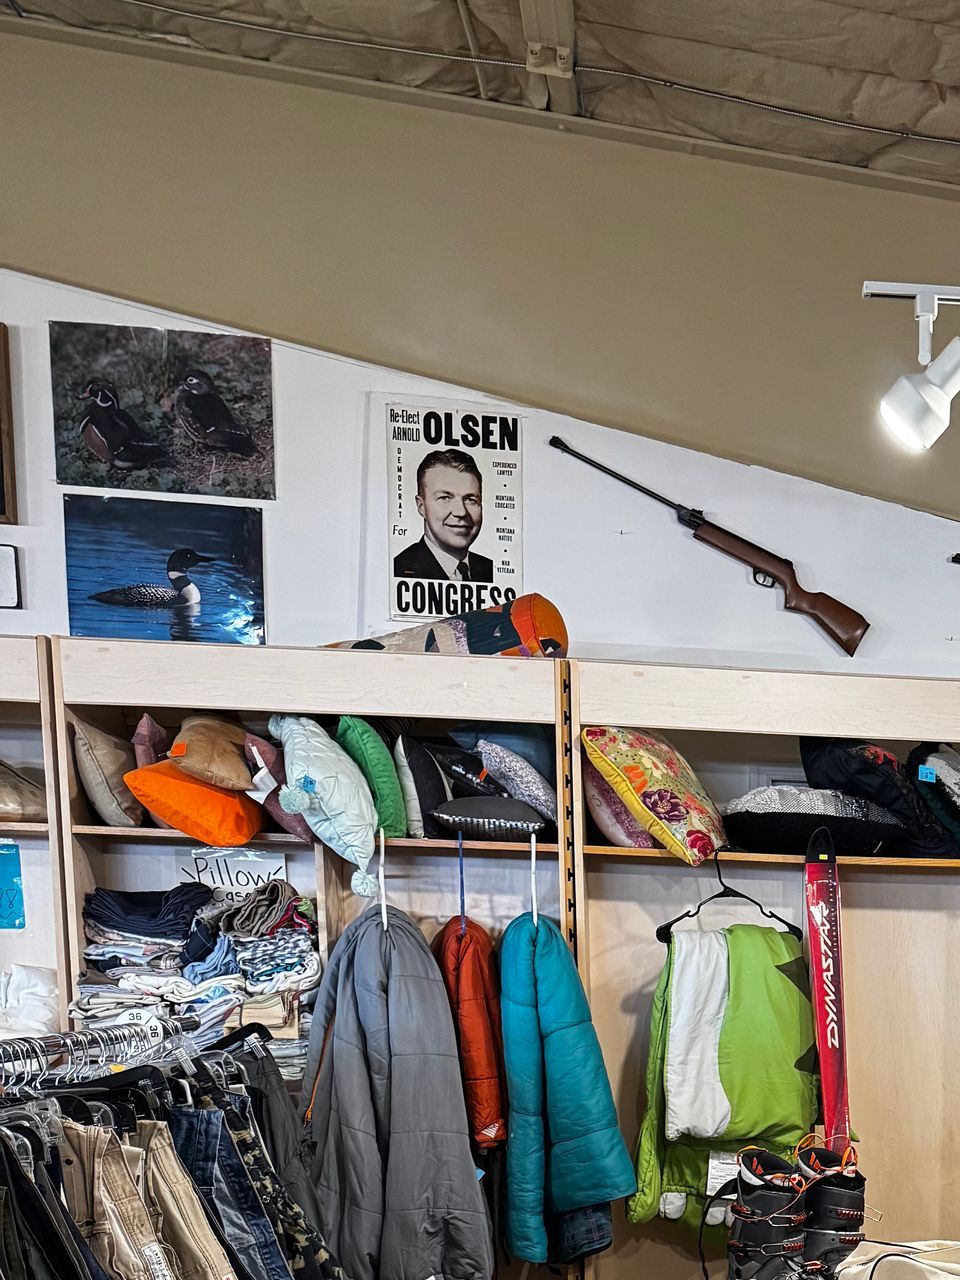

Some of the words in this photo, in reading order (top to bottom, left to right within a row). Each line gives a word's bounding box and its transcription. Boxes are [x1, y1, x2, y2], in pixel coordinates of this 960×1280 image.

[392, 426, 420, 442] ARNOLD
[423, 410, 518, 451] OLSEN
[392, 524, 407, 537] For
[194, 857, 271, 887] Pillow
[128, 1013, 142, 1021] 36
[149, 1025, 159, 1038] 36
